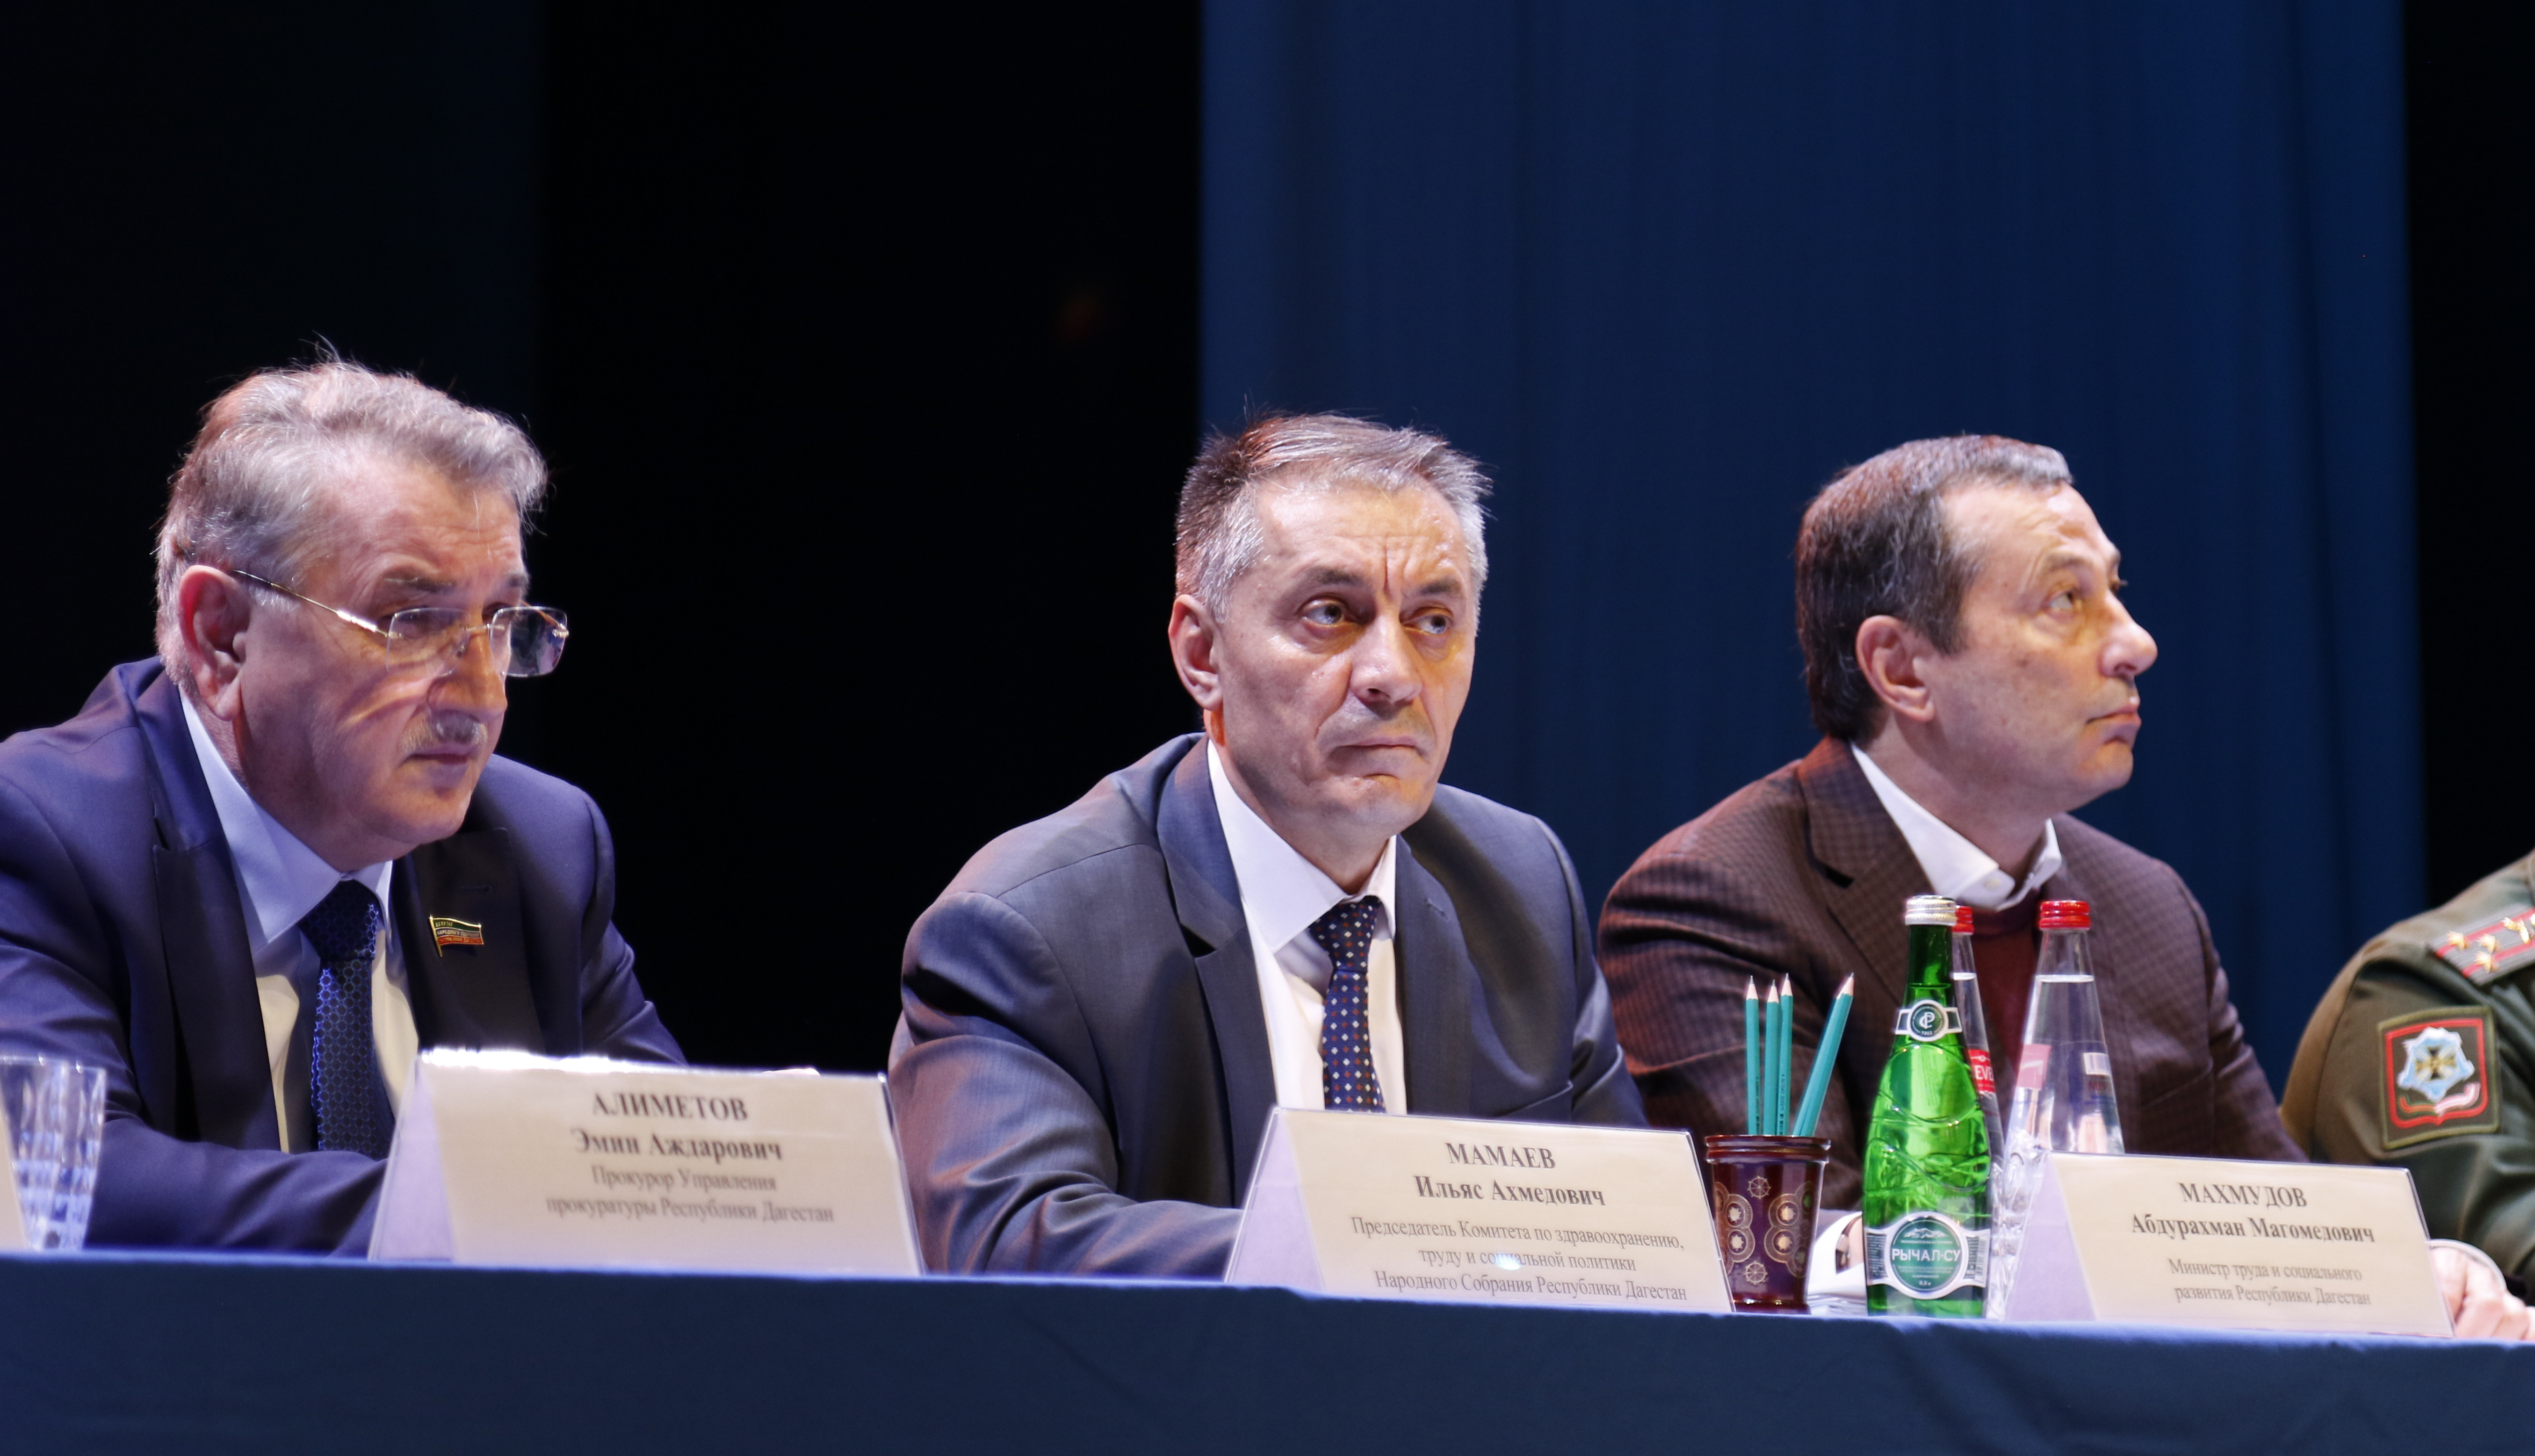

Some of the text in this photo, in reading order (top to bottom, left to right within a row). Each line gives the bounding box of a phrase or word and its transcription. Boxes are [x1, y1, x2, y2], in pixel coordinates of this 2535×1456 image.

[592, 1092, 748, 1121] АЛИМЕТОВ
[571, 1128, 783, 1164] Эмин Аждарович
[1445, 1142, 1556, 1169] МАМАЕВ
[591, 1165, 777, 1193] Прокурор Управления
[1414, 1175, 1606, 1206] Ильяс Ахмедович
[2179, 1182, 2307, 1208] МАХМУДОВ
[546, 1197, 834, 1223] прокуратуры Республики Дагестан
[1351, 1217, 1684, 1251] Председатель Комитета по здравоохранению,
[2133, 1214, 2376, 1242] Абдурахман Магомедович
[1419, 1250, 1637, 1271] труду и соальной политики
[2168, 1259, 2362, 1281] Министр труда и социального
[1374, 1271, 1688, 1301] Народного Собрания Республики Дагестан
[2174, 1285, 2372, 1306] развития Республики Дагестан
